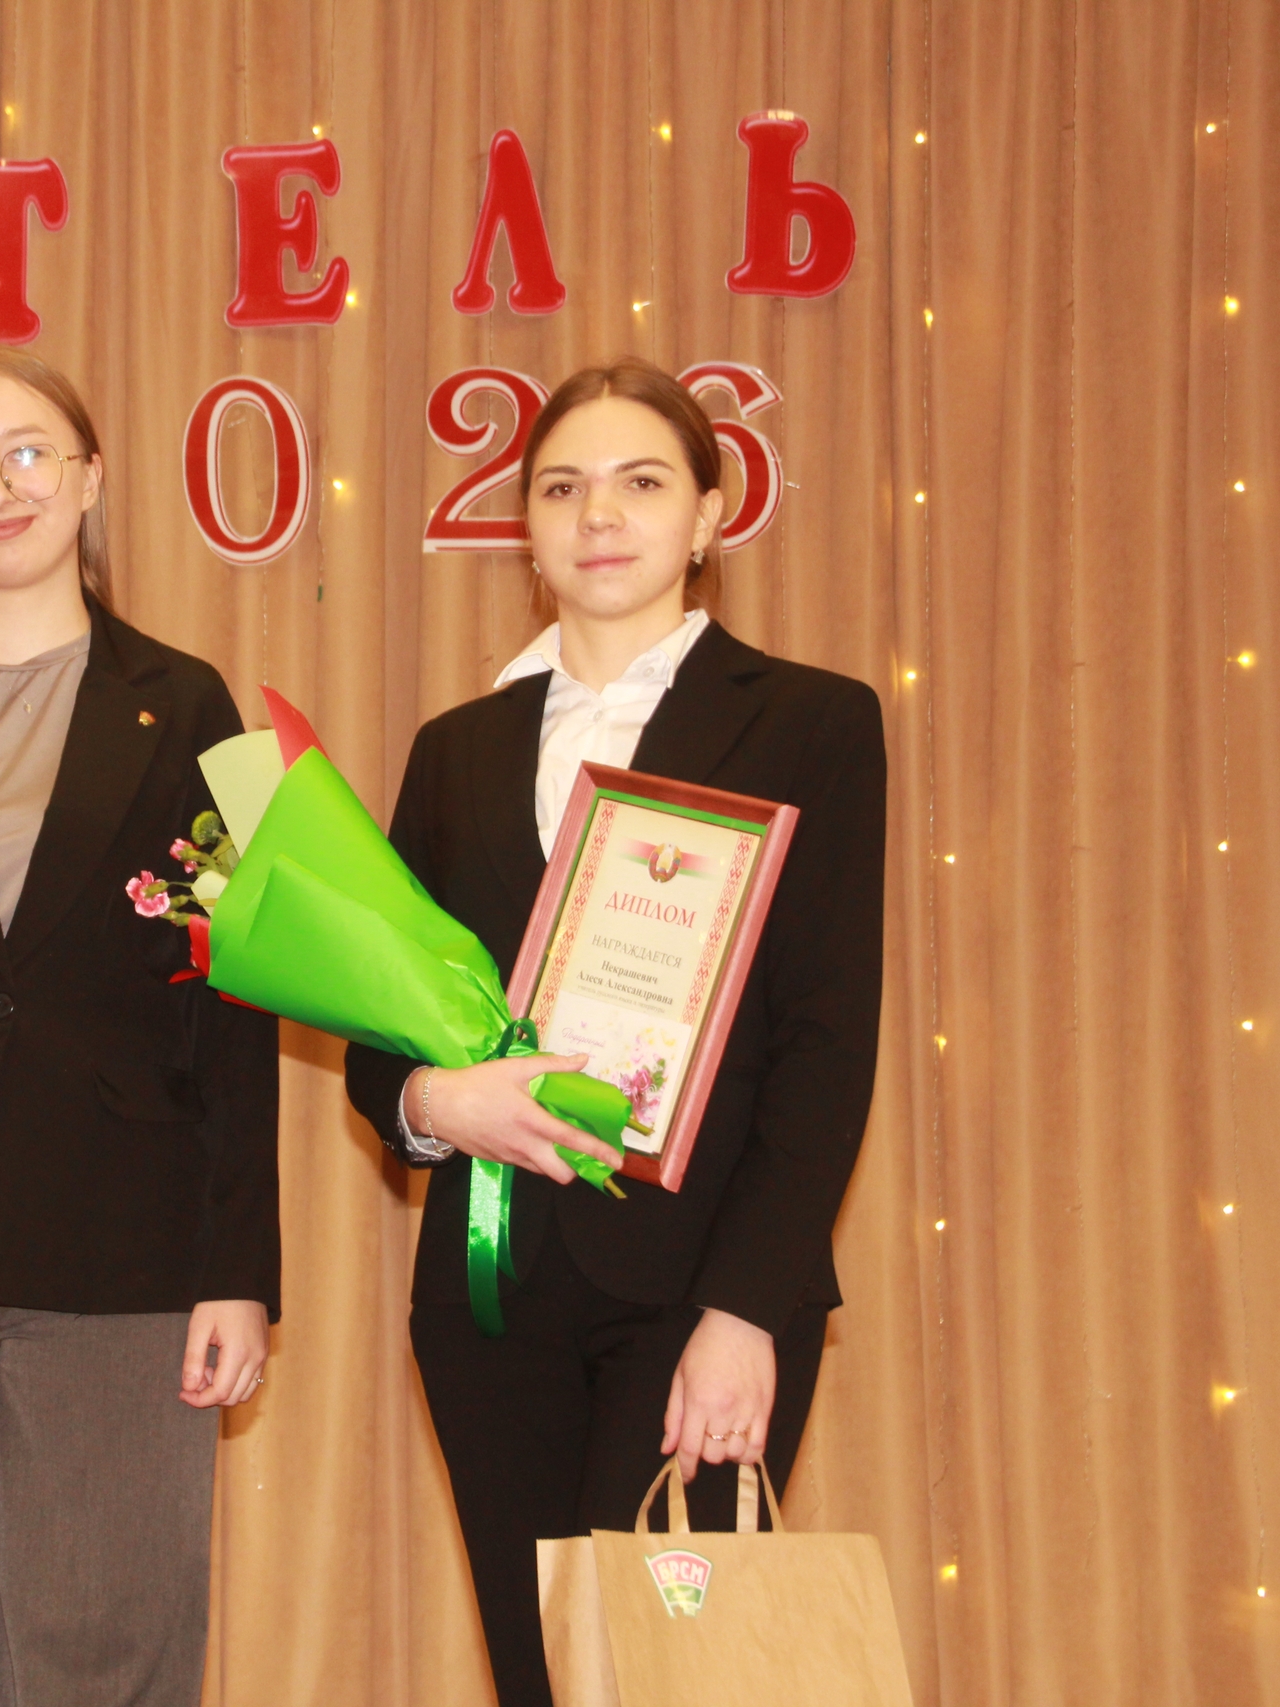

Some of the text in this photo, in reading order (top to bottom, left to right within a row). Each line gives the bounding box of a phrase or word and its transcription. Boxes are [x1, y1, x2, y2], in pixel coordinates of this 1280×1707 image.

[604, 890, 696, 929] ДИПЛОМ
[592, 934, 682, 969] НАГРАЖДАЕТСЯ
[577, 970, 673, 1006] Алеся Александровна
[601, 960, 658, 985] Некрашевич
[657, 1561, 705, 1586] БРСМ
